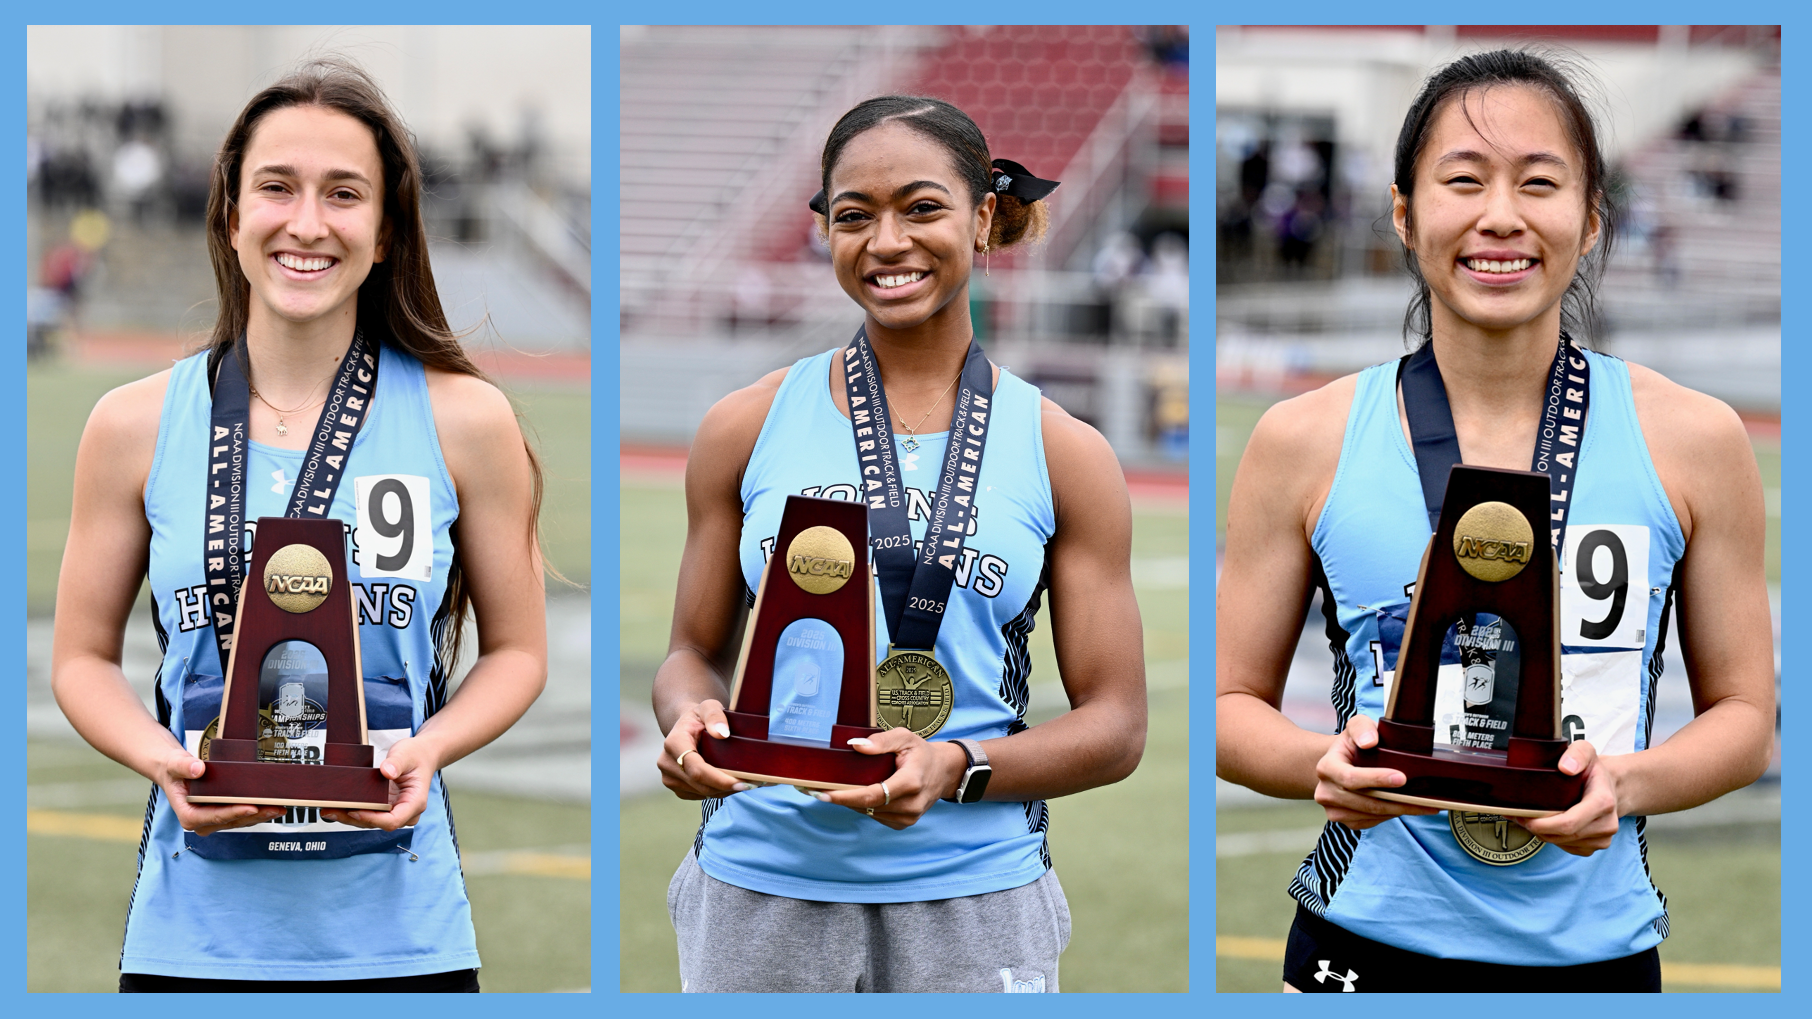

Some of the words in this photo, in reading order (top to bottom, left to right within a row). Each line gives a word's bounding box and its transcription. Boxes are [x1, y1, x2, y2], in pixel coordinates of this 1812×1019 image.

[352, 350, 360, 359] &
[858, 336, 870, 364] NCAA
[338, 357, 357, 388] TRACK
[864, 361, 880, 399] DIVISION
[872, 398, 882, 407] III
[960, 388, 971, 411] FIELD
[1543, 378, 1562, 439] OUTDOOR
[307, 340, 375, 516] LL-AMERICA
[318, 388, 346, 442] OUTDOOR
[845, 346, 886, 510] ALL-AMERICAN
[873, 406, 890, 451] OUTDOOR
[953, 415, 966, 441] TRACK
[233, 422, 243, 454] NCAA
[314, 441, 326, 452] III
[1540, 439, 1553, 451] III
[1551, 339, 1587, 547] ALL-AMERIC
[297, 451, 321, 499] DIVISION
[881, 450, 896, 477] TRACK
[944, 440, 961, 485] OUTDOOR
[231, 455, 242, 503] DIVISION
[938, 394, 989, 571] ALL-AMERICAN
[941, 483, 952, 493] III
[230, 503, 240, 513] III
[290, 499, 306, 519] CAA
[887, 484, 900, 508] FIELD
[368, 478, 415, 572] 9
[931, 492, 950, 534] DIVISION
[208, 425, 234, 651] ALL-AMERICAN
[228, 514, 240, 572] OUTDOOR
[874, 534, 911, 550] 2025
[923, 534, 940, 565] NCAA
[1457, 535, 1530, 564] NCAA
[790, 553, 852, 579] NCAA
[230, 573, 242, 604] TRAC
[267, 574, 330, 596] NCAA
[1575, 528, 1629, 641] 9
[908, 596, 946, 614] 2025
[786, 636, 827, 650] DIVISION
[801, 629, 826, 640] 2025
[1502, 640, 1515, 652] III
[880, 655, 944, 678] ALL-AMERICAN
[786, 705, 807, 715] TRACK
[1467, 731, 1495, 742] METERS
[1485, 719, 1508, 730] FIELD
[1471, 740, 1494, 750] PLACE
[268, 841, 303, 852] GENEVA,
[305, 841, 327, 851] OHIO
[1457, 825, 1481, 853] DIVISION
[1492, 848, 1529, 860] OUTDOOR
